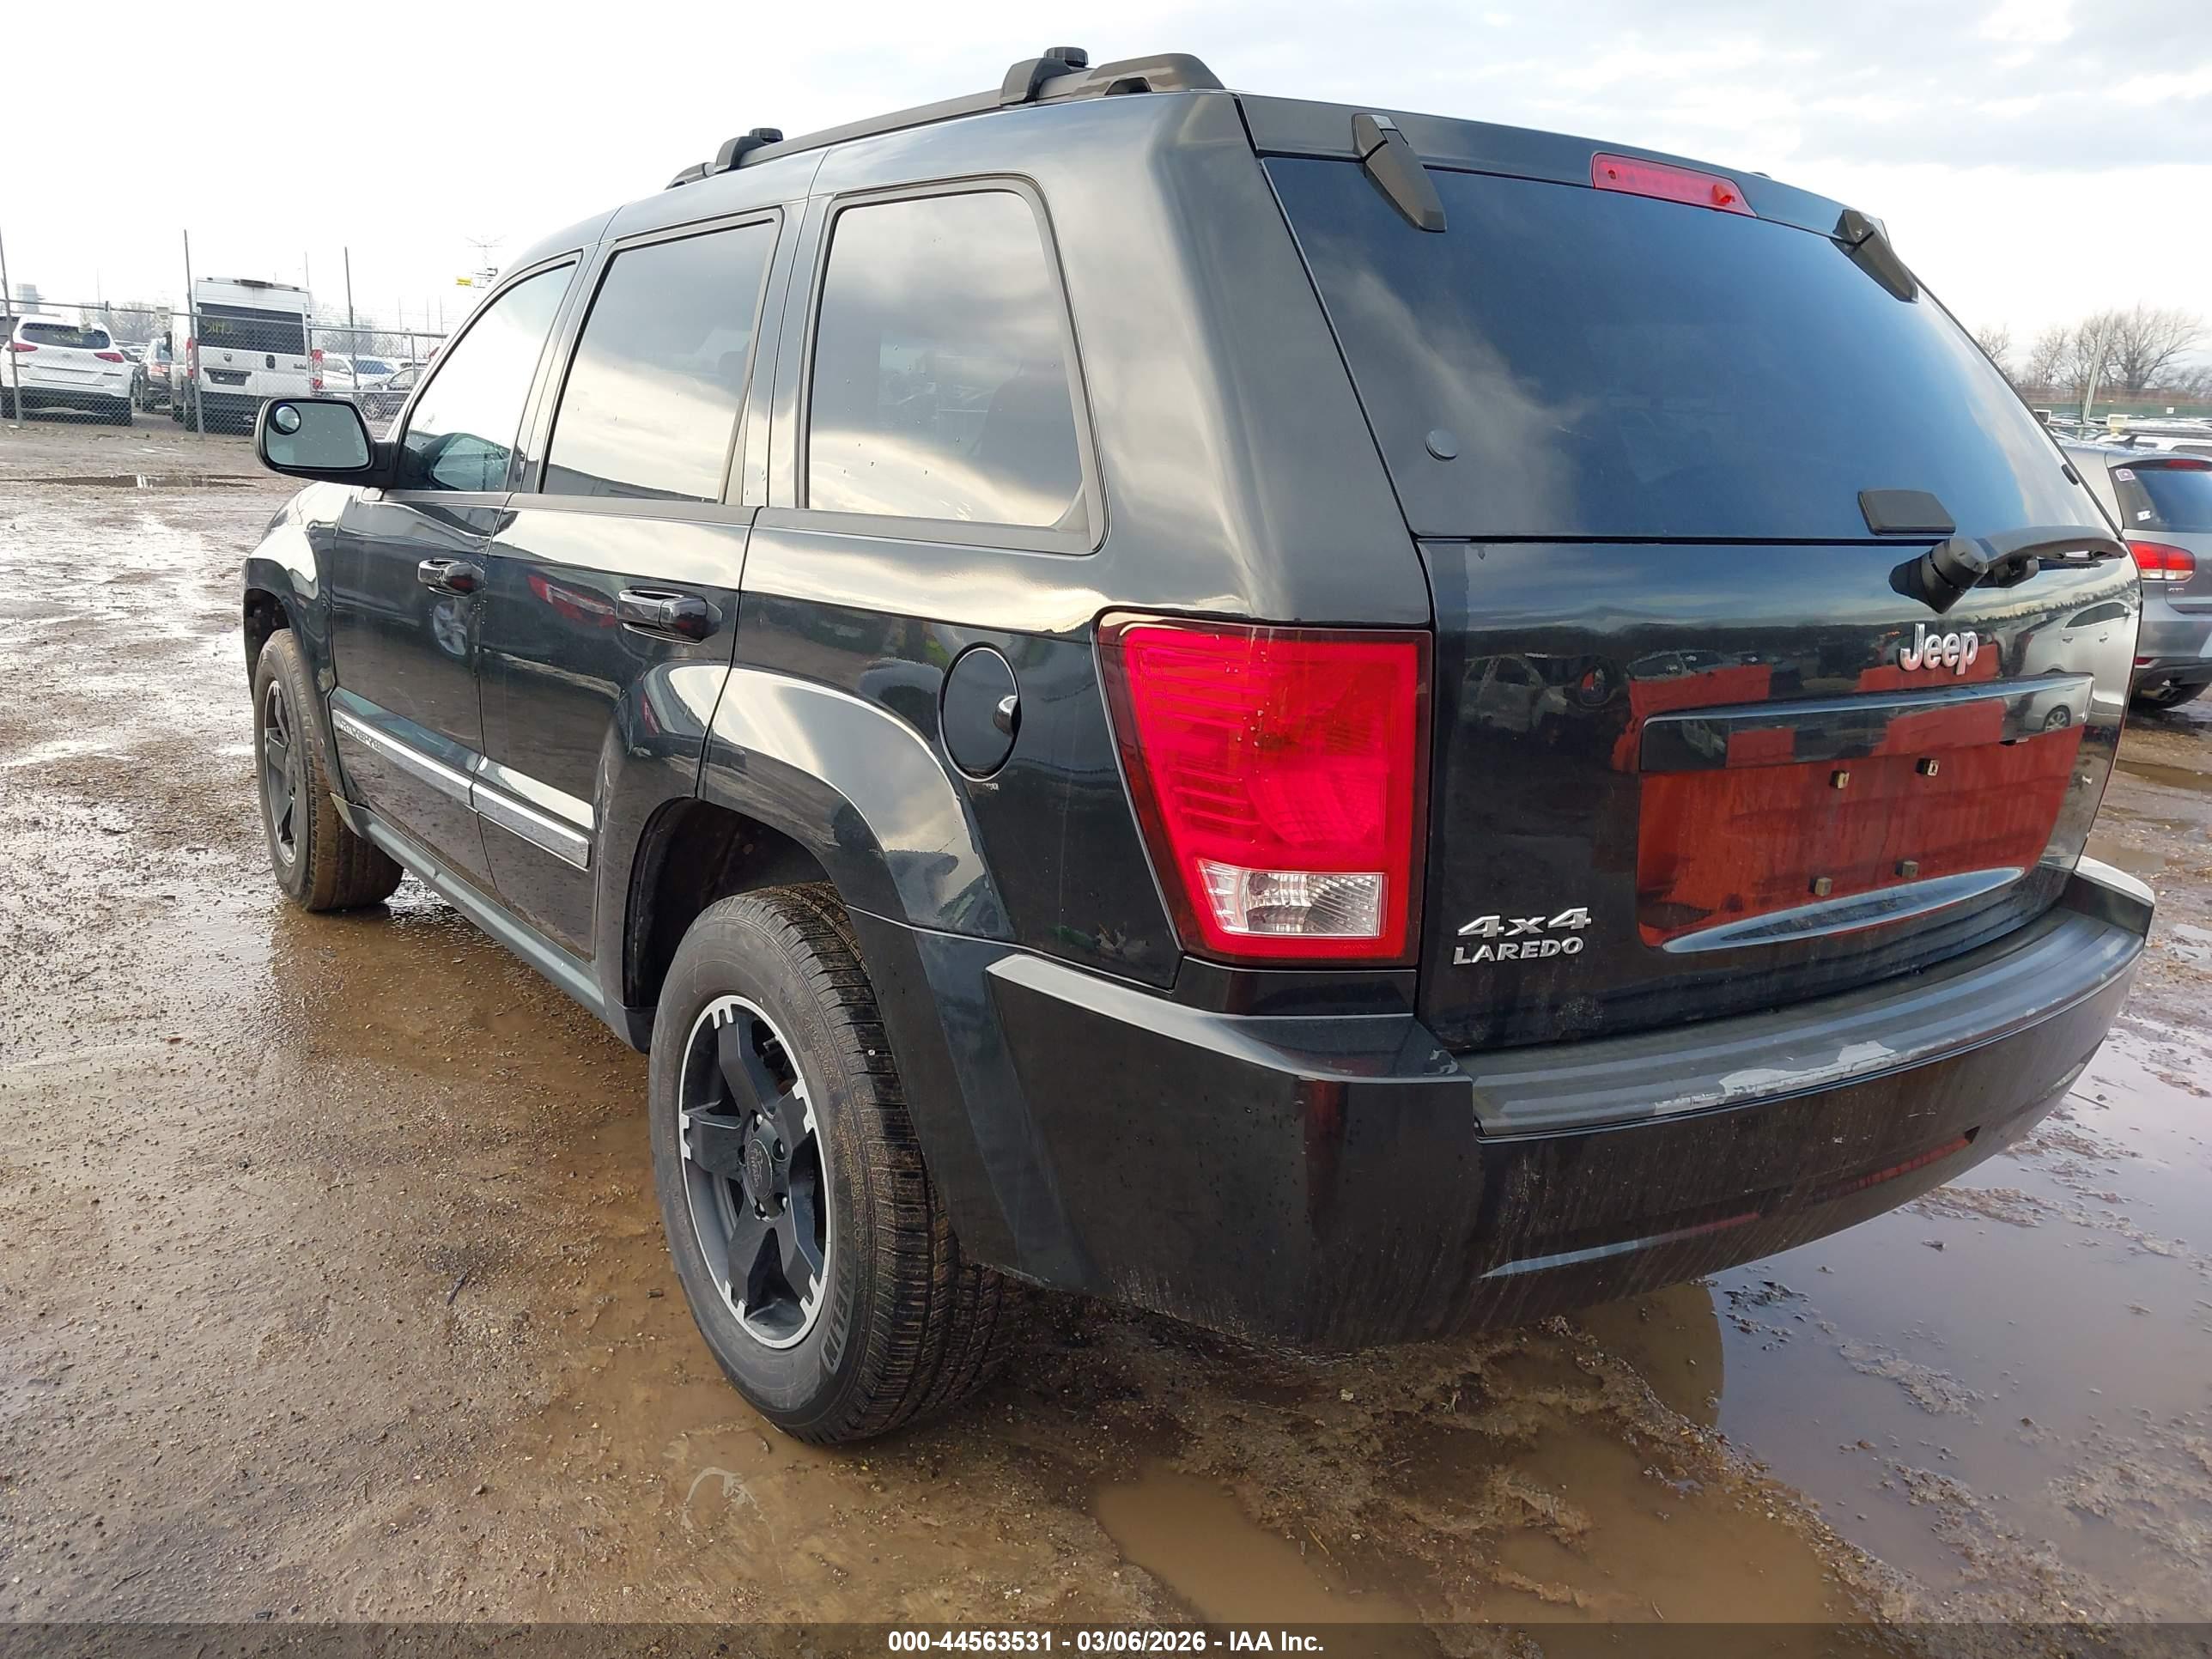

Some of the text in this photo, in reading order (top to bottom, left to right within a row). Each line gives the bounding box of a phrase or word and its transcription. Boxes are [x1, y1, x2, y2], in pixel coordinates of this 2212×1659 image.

[1899, 623, 1978, 676] Jeep
[1457, 907, 1592, 938] 4x4
[1453, 936, 1584, 965] LAREDO
